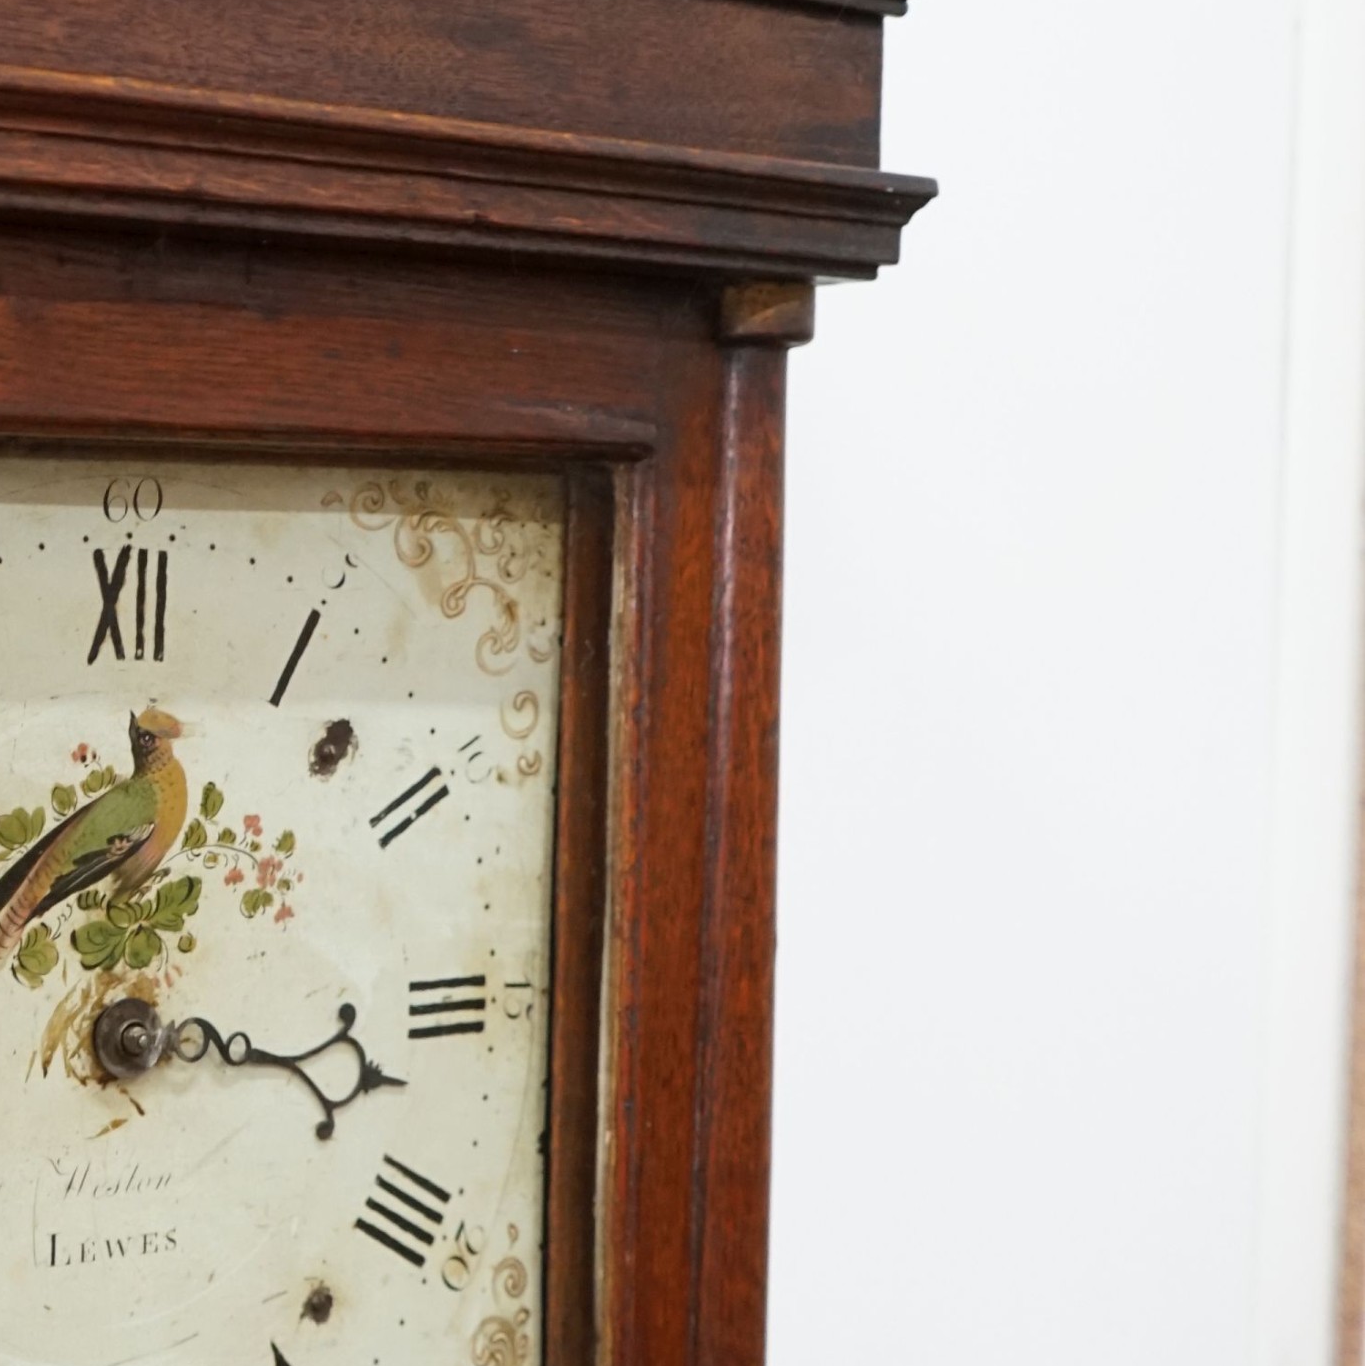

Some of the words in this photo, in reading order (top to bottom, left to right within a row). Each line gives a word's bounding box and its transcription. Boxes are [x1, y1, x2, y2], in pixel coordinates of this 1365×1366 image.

[103, 478, 163, 523] 60
[87, 545, 168, 665] XII
[268, 608, 321, 708] I
[369, 766, 449, 850] II
[408, 975, 486, 1039] III
